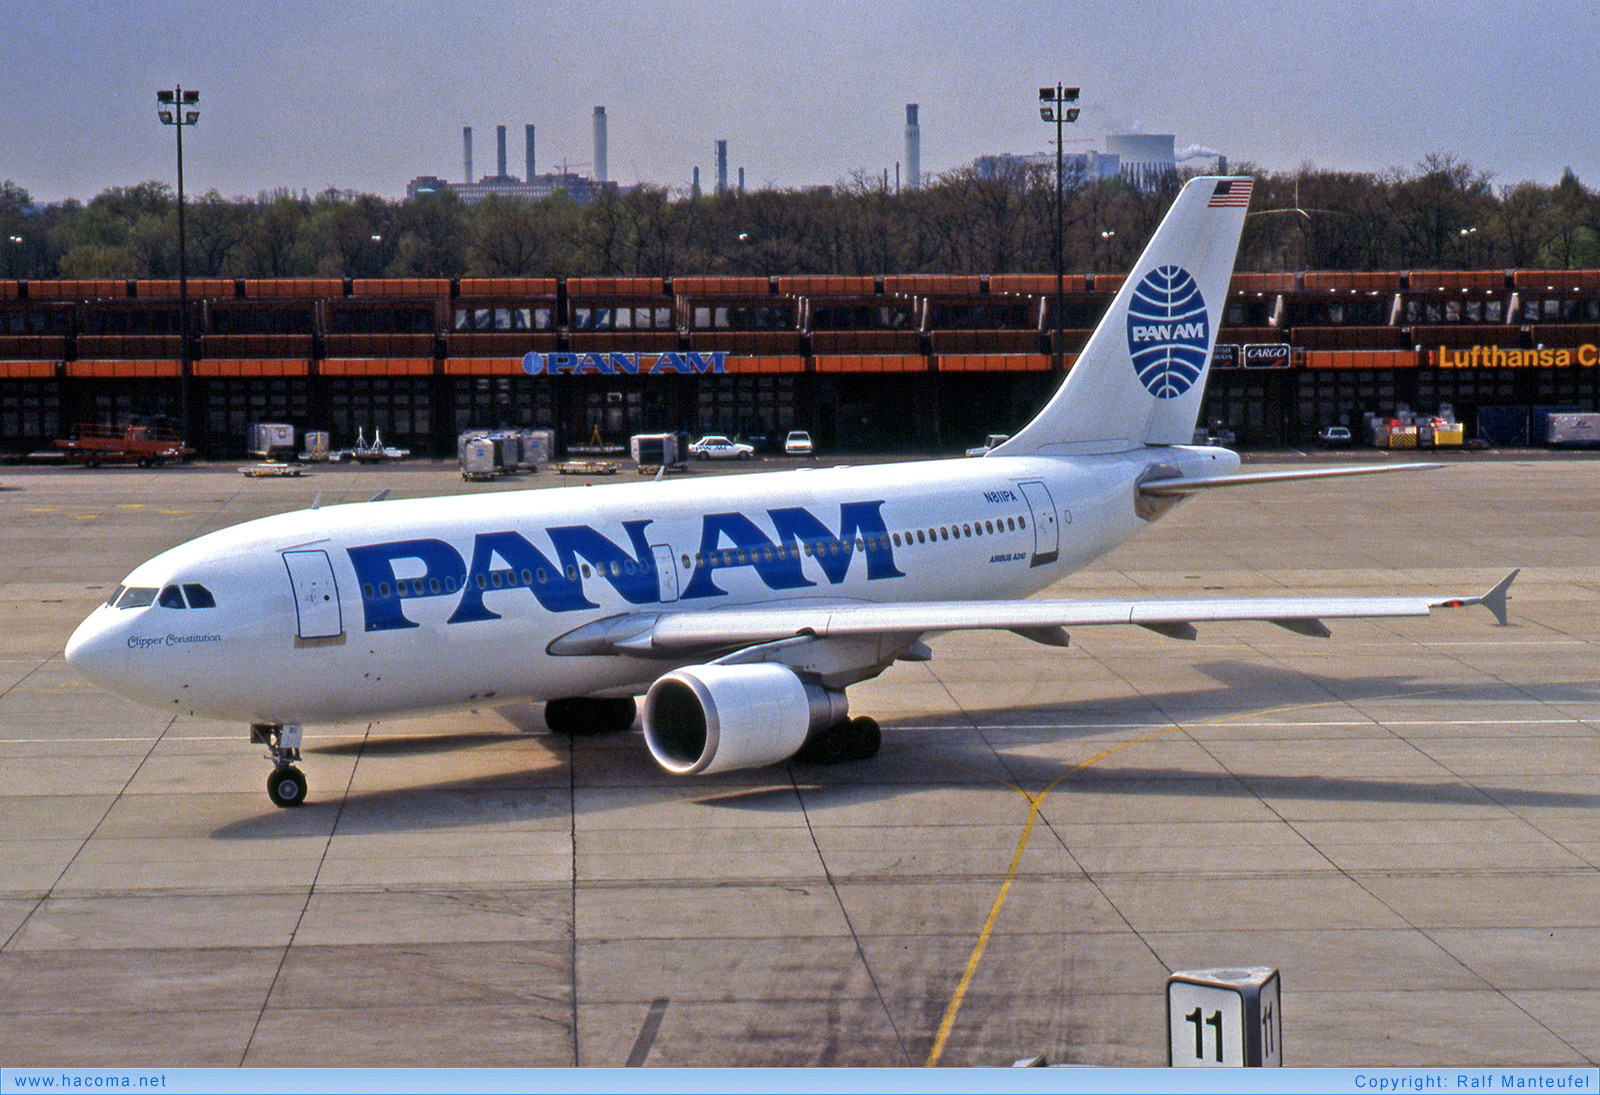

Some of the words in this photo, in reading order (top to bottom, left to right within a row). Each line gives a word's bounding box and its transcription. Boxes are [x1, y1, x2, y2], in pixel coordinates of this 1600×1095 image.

[1132, 324, 1172, 341] PAN
[1172, 322, 1204, 340] AM
[547, 352, 639, 375] PAN
[648, 351, 731, 374] AM
[1247, 347, 1287, 358] CARGO
[1439, 344, 1571, 368] Lufthansa
[1577, 343, 1600, 367] C
[983, 490, 1018, 503] N811PA
[346, 518, 660, 632] PAN
[680, 500, 906, 600] AM
[127, 635, 163, 649] Clipper
[165, 633, 222, 647] Constitution
[1185, 1006, 1223, 1063] 11
[1262, 1001, 1274, 1059] 11
